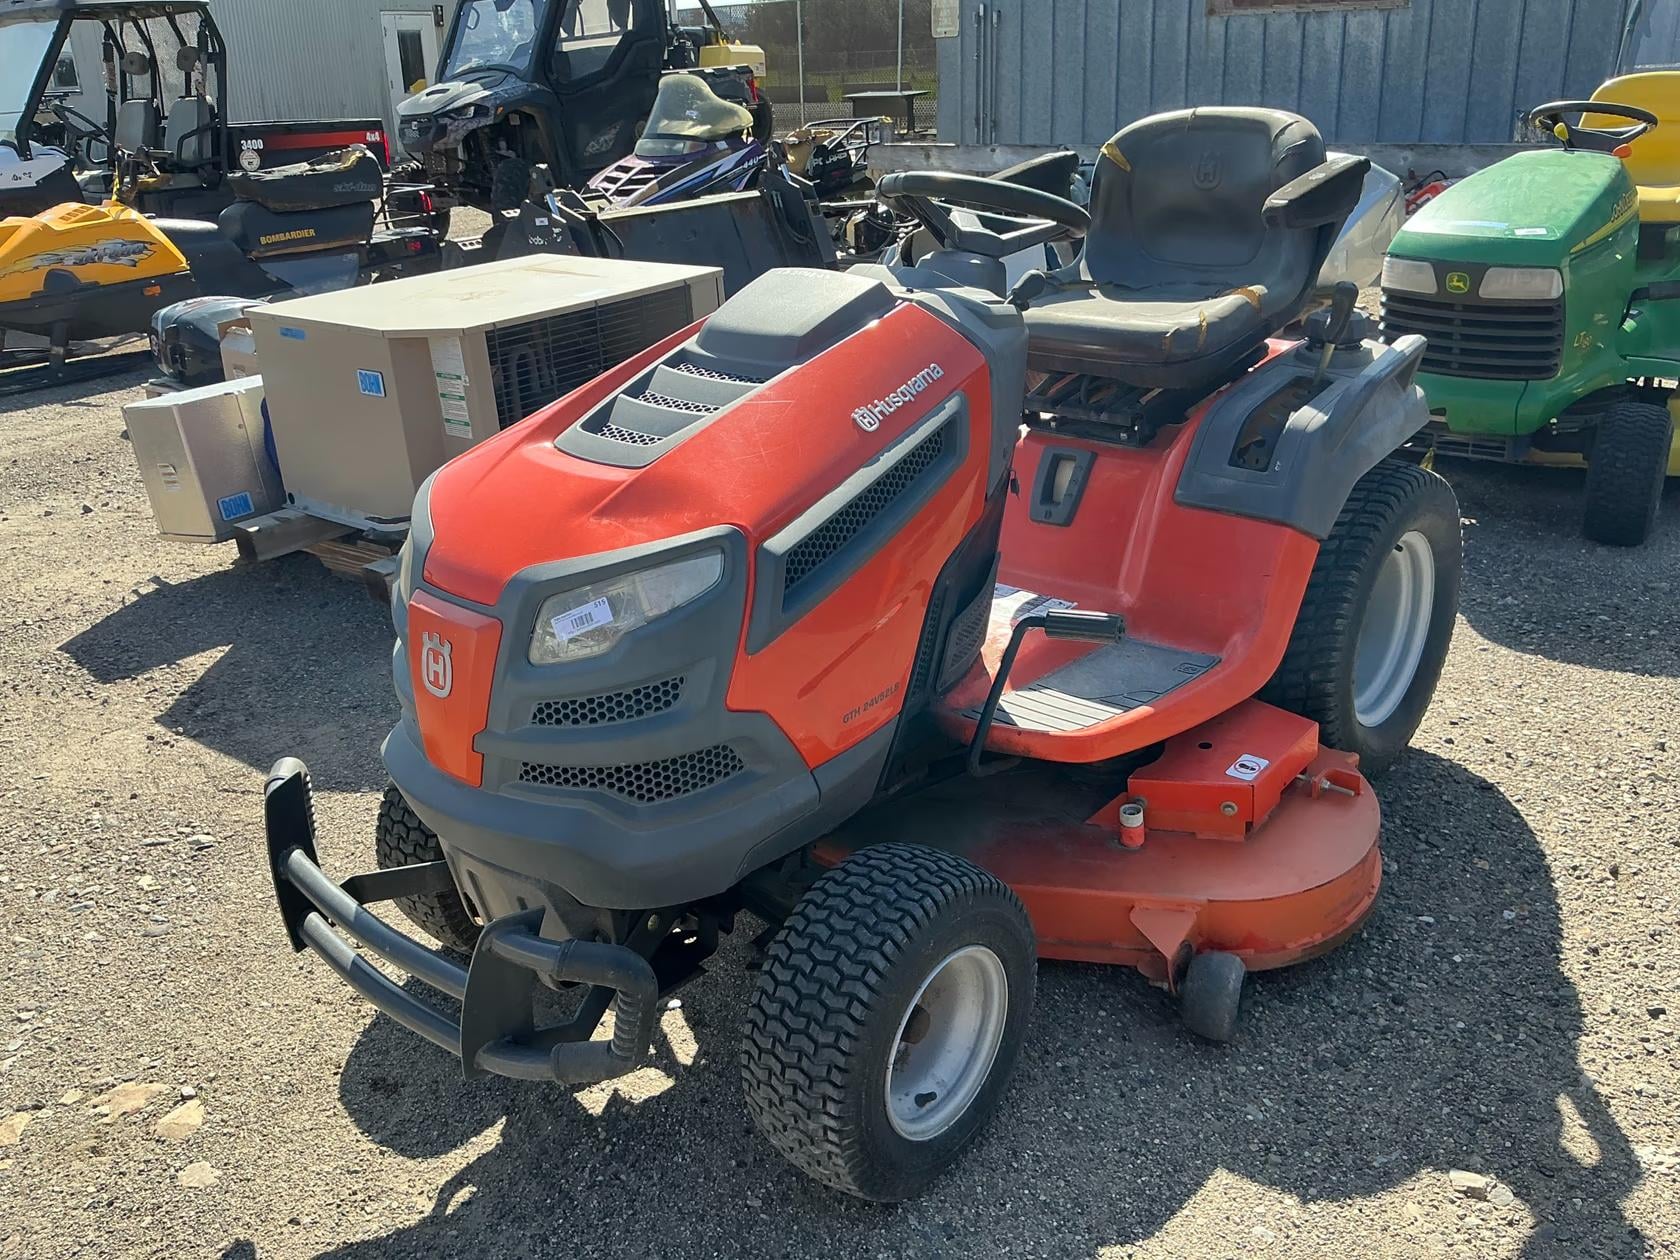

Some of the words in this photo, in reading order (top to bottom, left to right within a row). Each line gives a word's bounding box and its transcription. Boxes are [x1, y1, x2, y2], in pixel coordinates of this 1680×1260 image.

[240, 139, 264, 150] 3400
[366, 132, 381, 142] 4x4
[260, 228, 316, 245] BOMBARDIER
[359, 371, 382, 395] BOHN
[867, 363, 945, 420] Husqvarna
[221, 494, 252, 519] BOHN
[593, 598, 606, 609] 515
[843, 706, 861, 724] GTH
